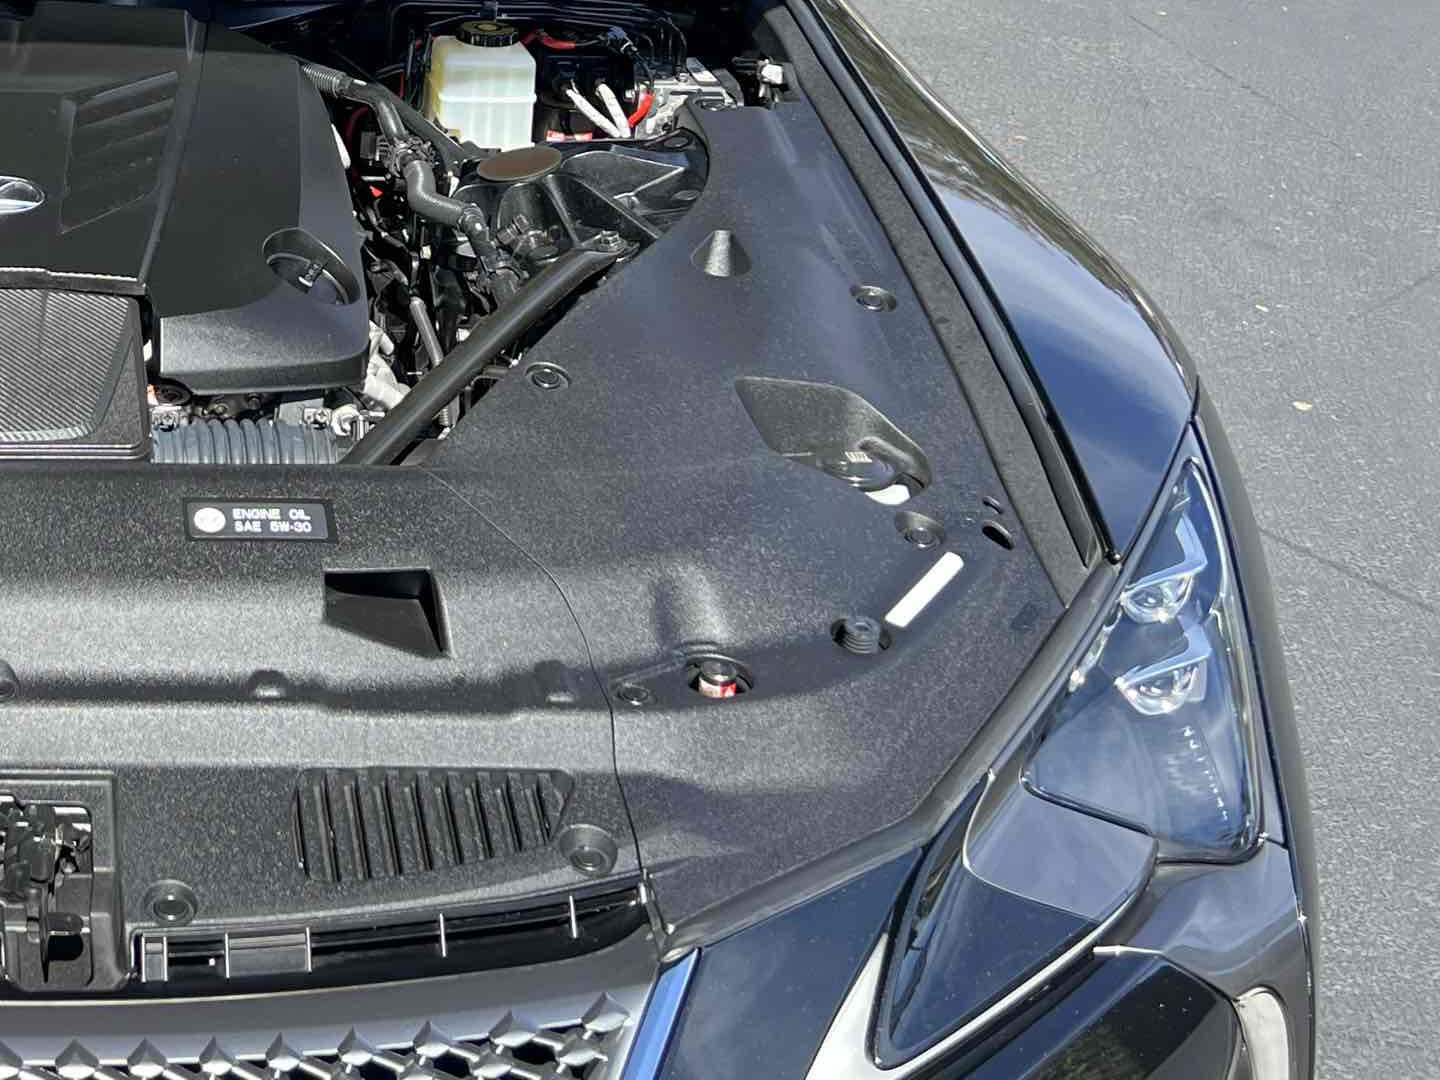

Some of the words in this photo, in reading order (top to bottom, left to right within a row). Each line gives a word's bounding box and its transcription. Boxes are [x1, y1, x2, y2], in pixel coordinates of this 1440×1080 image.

[232, 508, 281, 520] ENGINE
[289, 508, 311, 520] OIL
[234, 521, 262, 532] SAE
[270, 521, 312, 532] 5W-30
